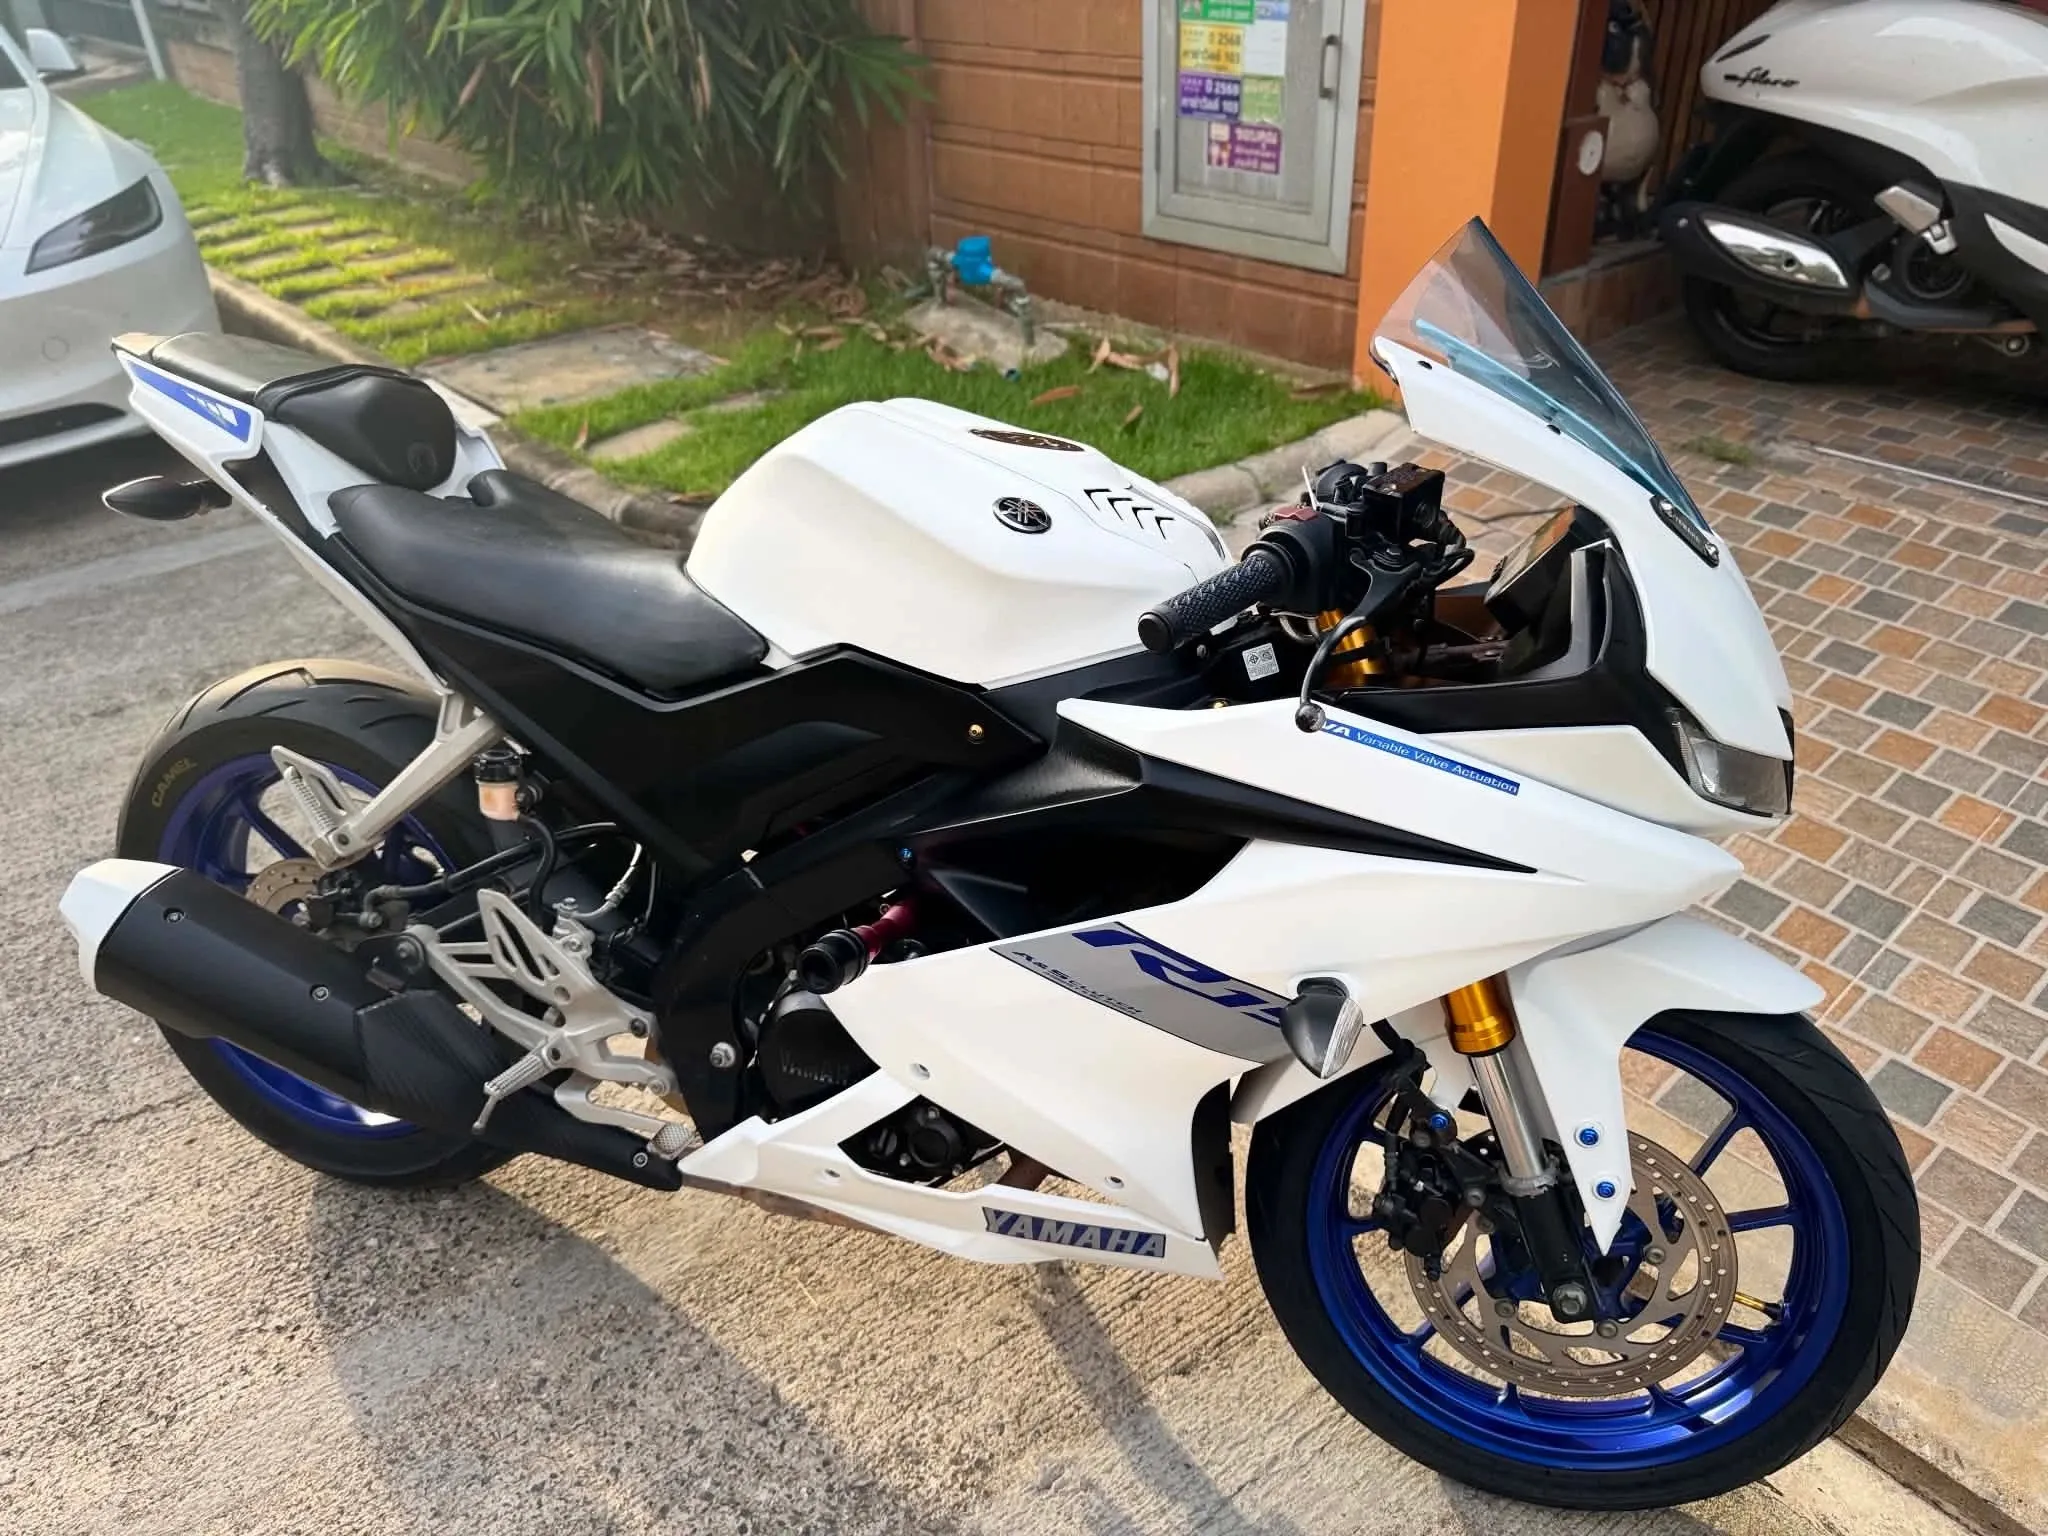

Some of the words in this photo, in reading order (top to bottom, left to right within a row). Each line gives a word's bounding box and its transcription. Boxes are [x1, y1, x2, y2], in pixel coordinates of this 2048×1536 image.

[1355, 730, 1410, 757] Variable
[1413, 750, 1449, 770] Valve
[1451, 763, 1518, 794] Actuation
[984, 1206, 1165, 1257] YAMAHA
